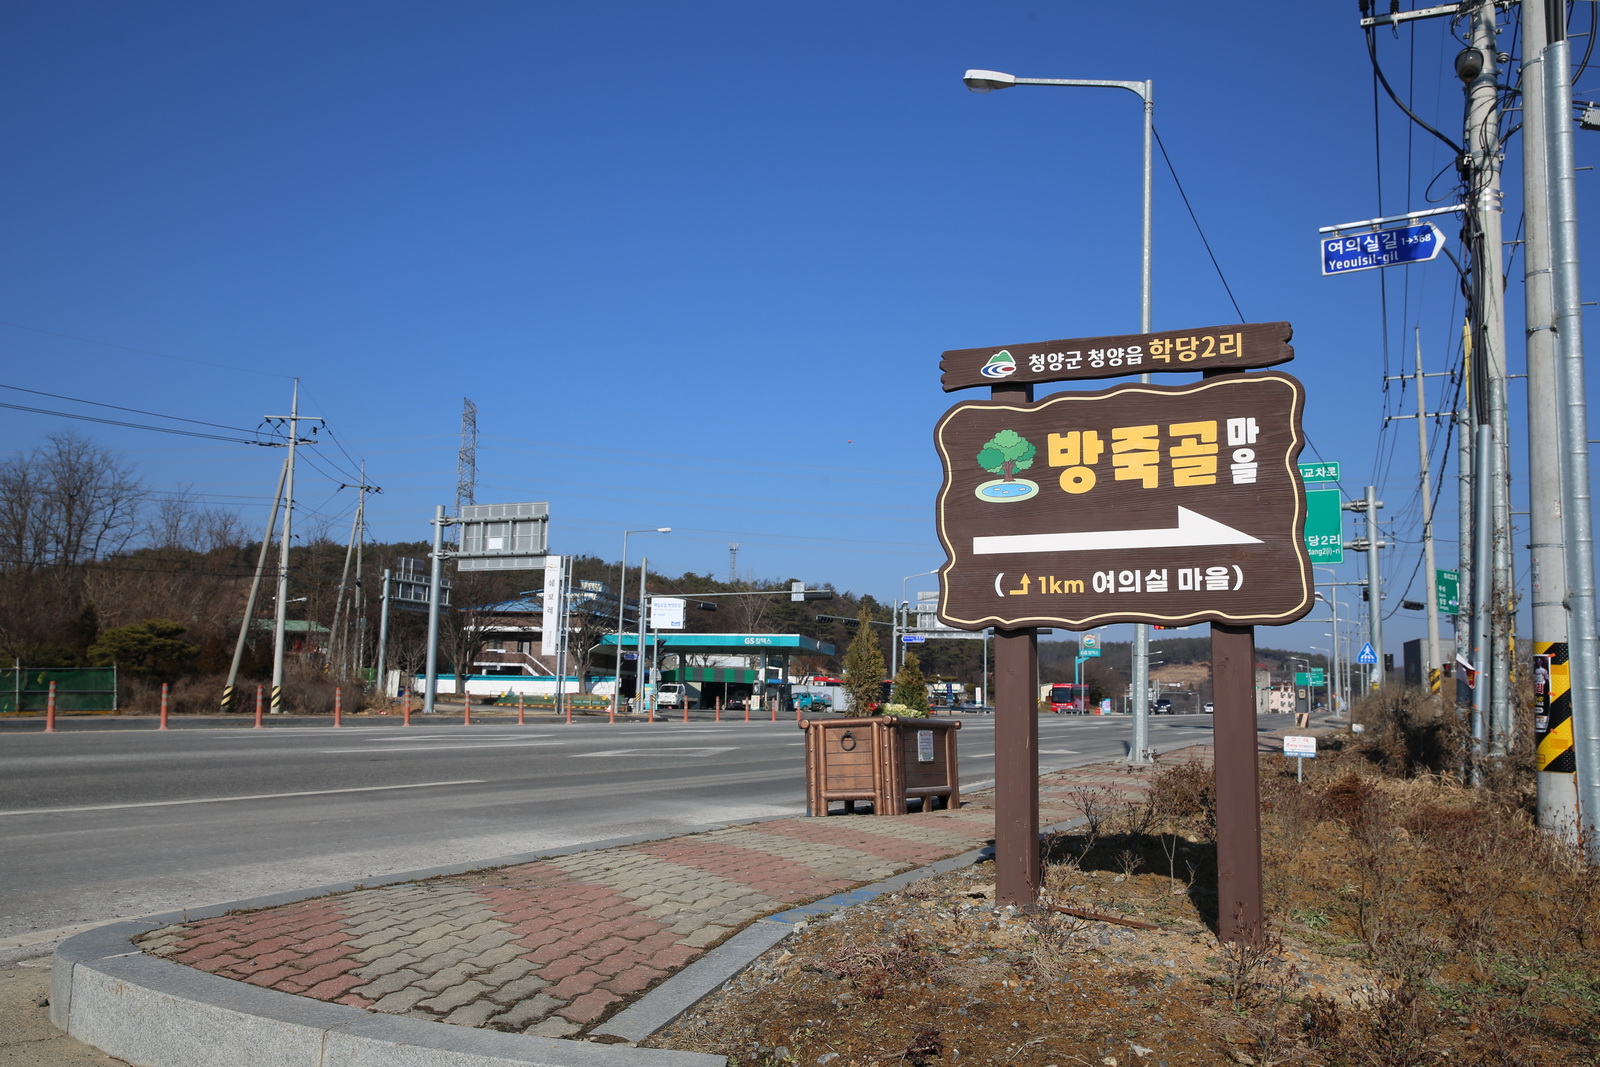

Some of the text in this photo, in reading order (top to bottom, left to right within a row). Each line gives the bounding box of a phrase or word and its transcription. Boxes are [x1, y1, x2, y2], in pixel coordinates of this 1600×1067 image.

[1328, 231, 1397, 255] 여의실길
[1329, 250, 1399, 271] Yeouisil-gil
[1028, 332, 1243, 373] 청양군 청양읍 학당2리
[1048, 417, 1260, 494] 방죽골 마을
[1300, 466, 1338, 478] 교차로
[1304, 534, 1341, 547] 당2리
[1038, 576, 1084, 594] 1km
[1092, 568, 1168, 593] 여의실
[744, 637, 755, 645] GS
